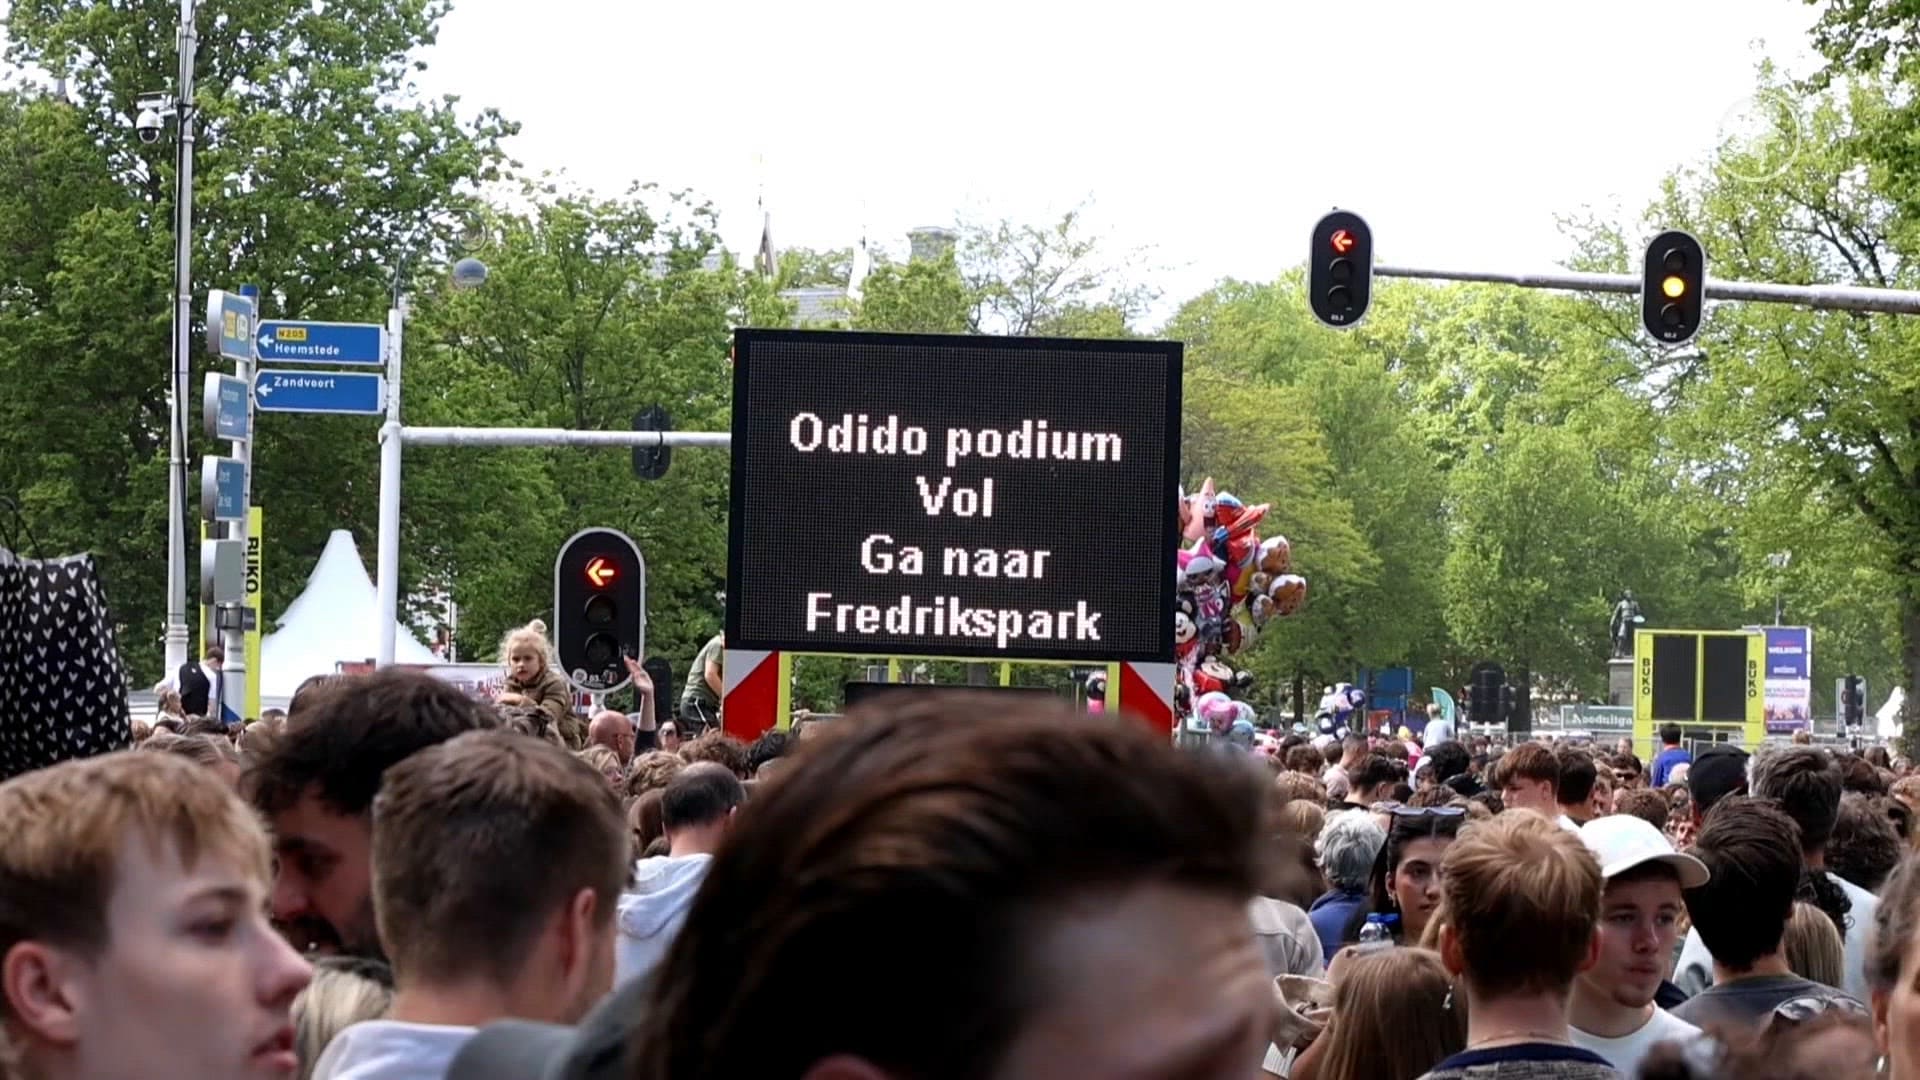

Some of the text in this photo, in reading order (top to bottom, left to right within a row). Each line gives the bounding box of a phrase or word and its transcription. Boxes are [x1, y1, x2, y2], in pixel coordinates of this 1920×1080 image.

[275, 343, 340, 355] Heemstede
[274, 376, 335, 388] Zandvoort
[791, 413, 1122, 468] Odido podium
[916, 476, 993, 517] Vol
[862, 535, 1050, 578] Ga naar
[807, 592, 1102, 648] Fredrikspark
[1642, 658, 1650, 695] BUKO
[1749, 660, 1757, 698] BUKO
